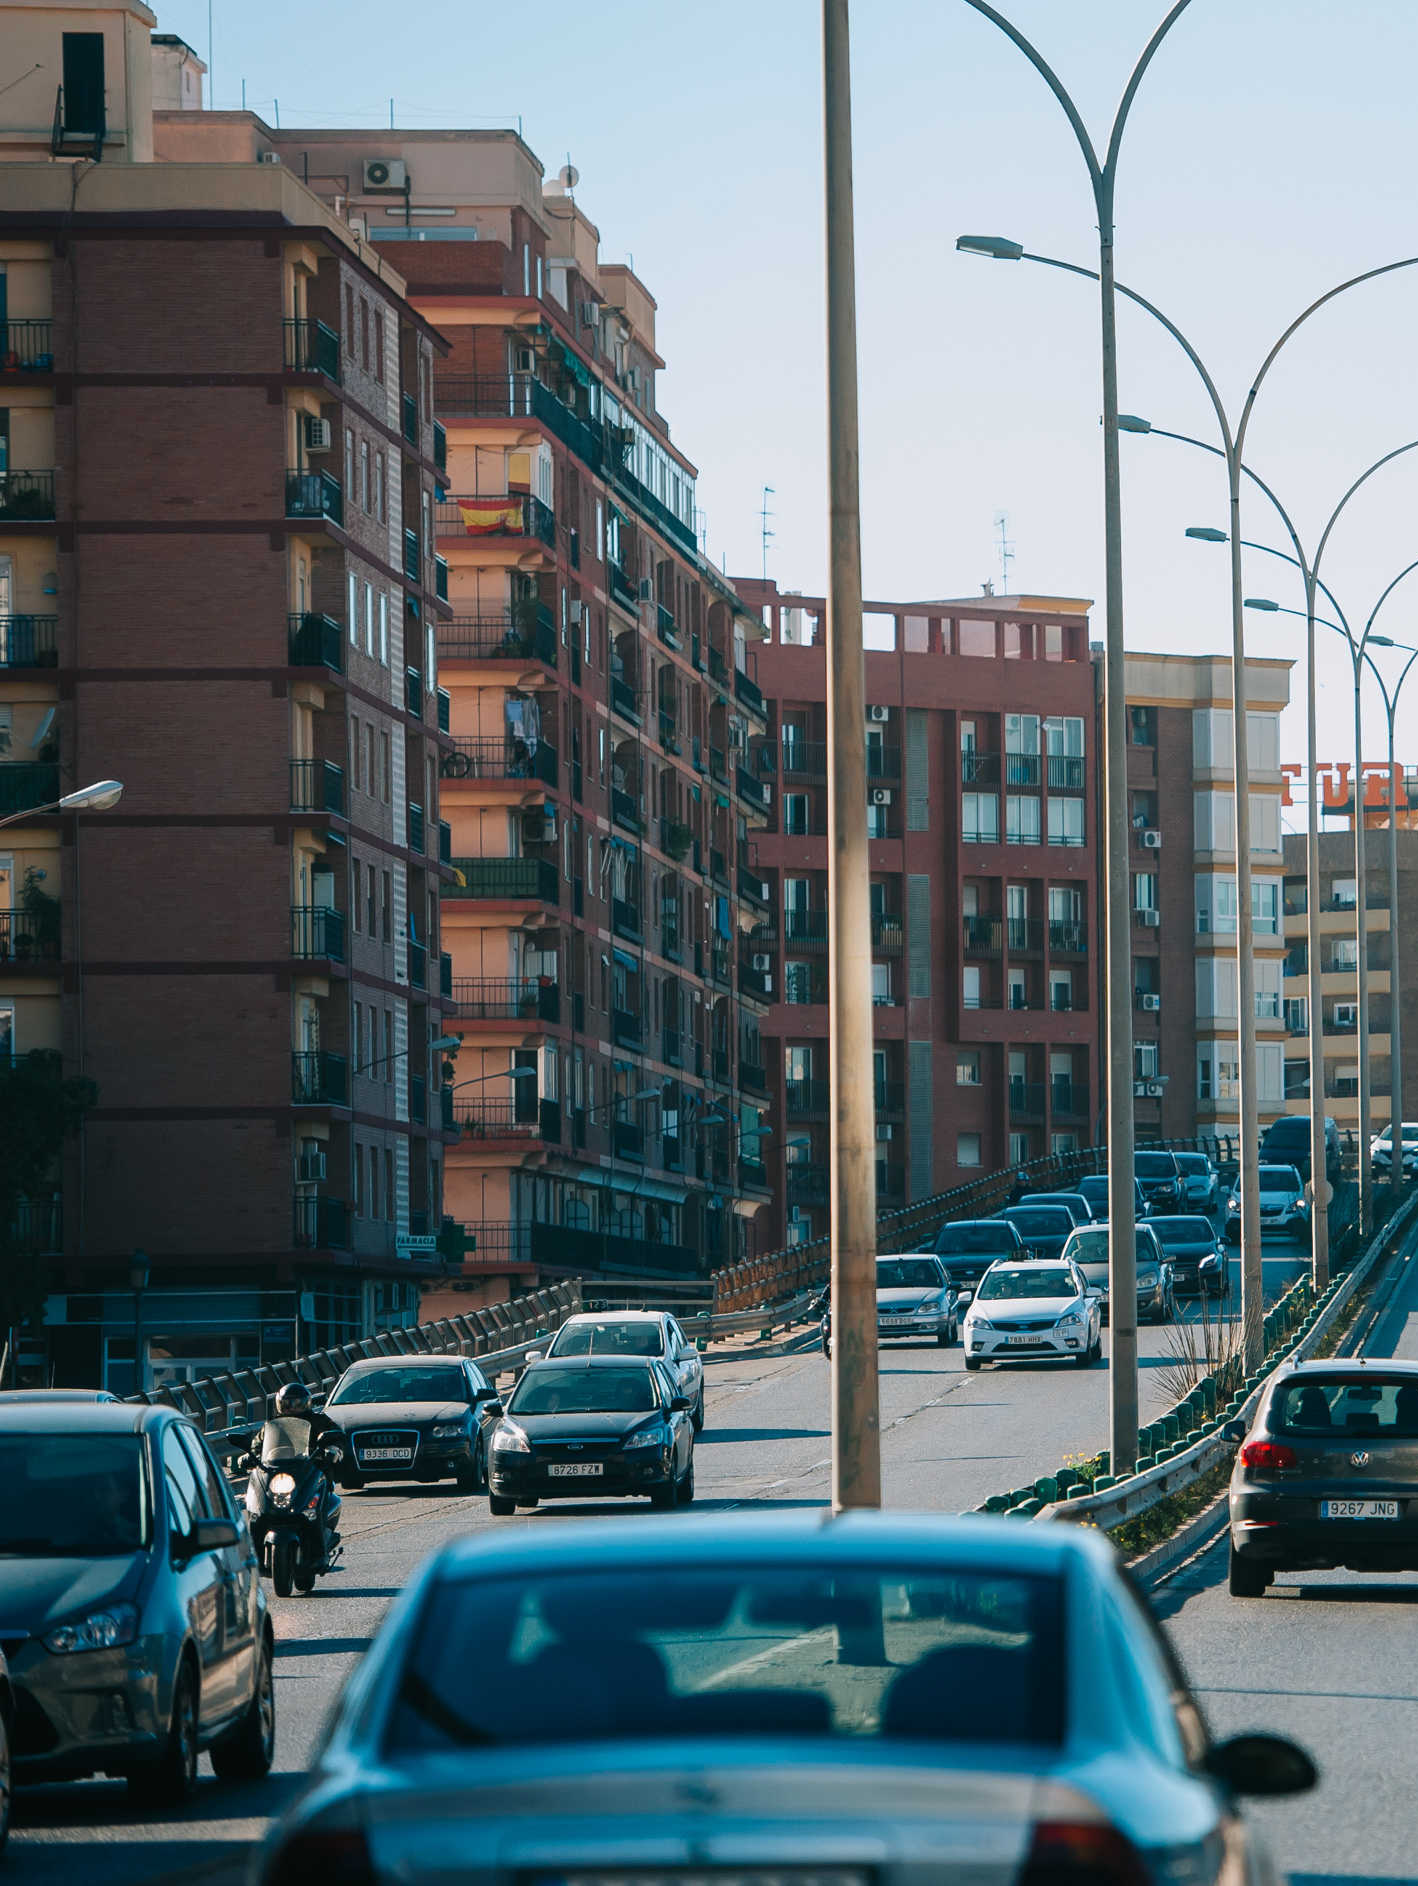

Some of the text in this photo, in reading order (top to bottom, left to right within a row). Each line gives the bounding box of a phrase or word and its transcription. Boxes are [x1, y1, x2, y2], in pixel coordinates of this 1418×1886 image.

[553, 1465, 579, 1475] 8726
[1331, 1502, 1395, 1515] 9267 JNG
